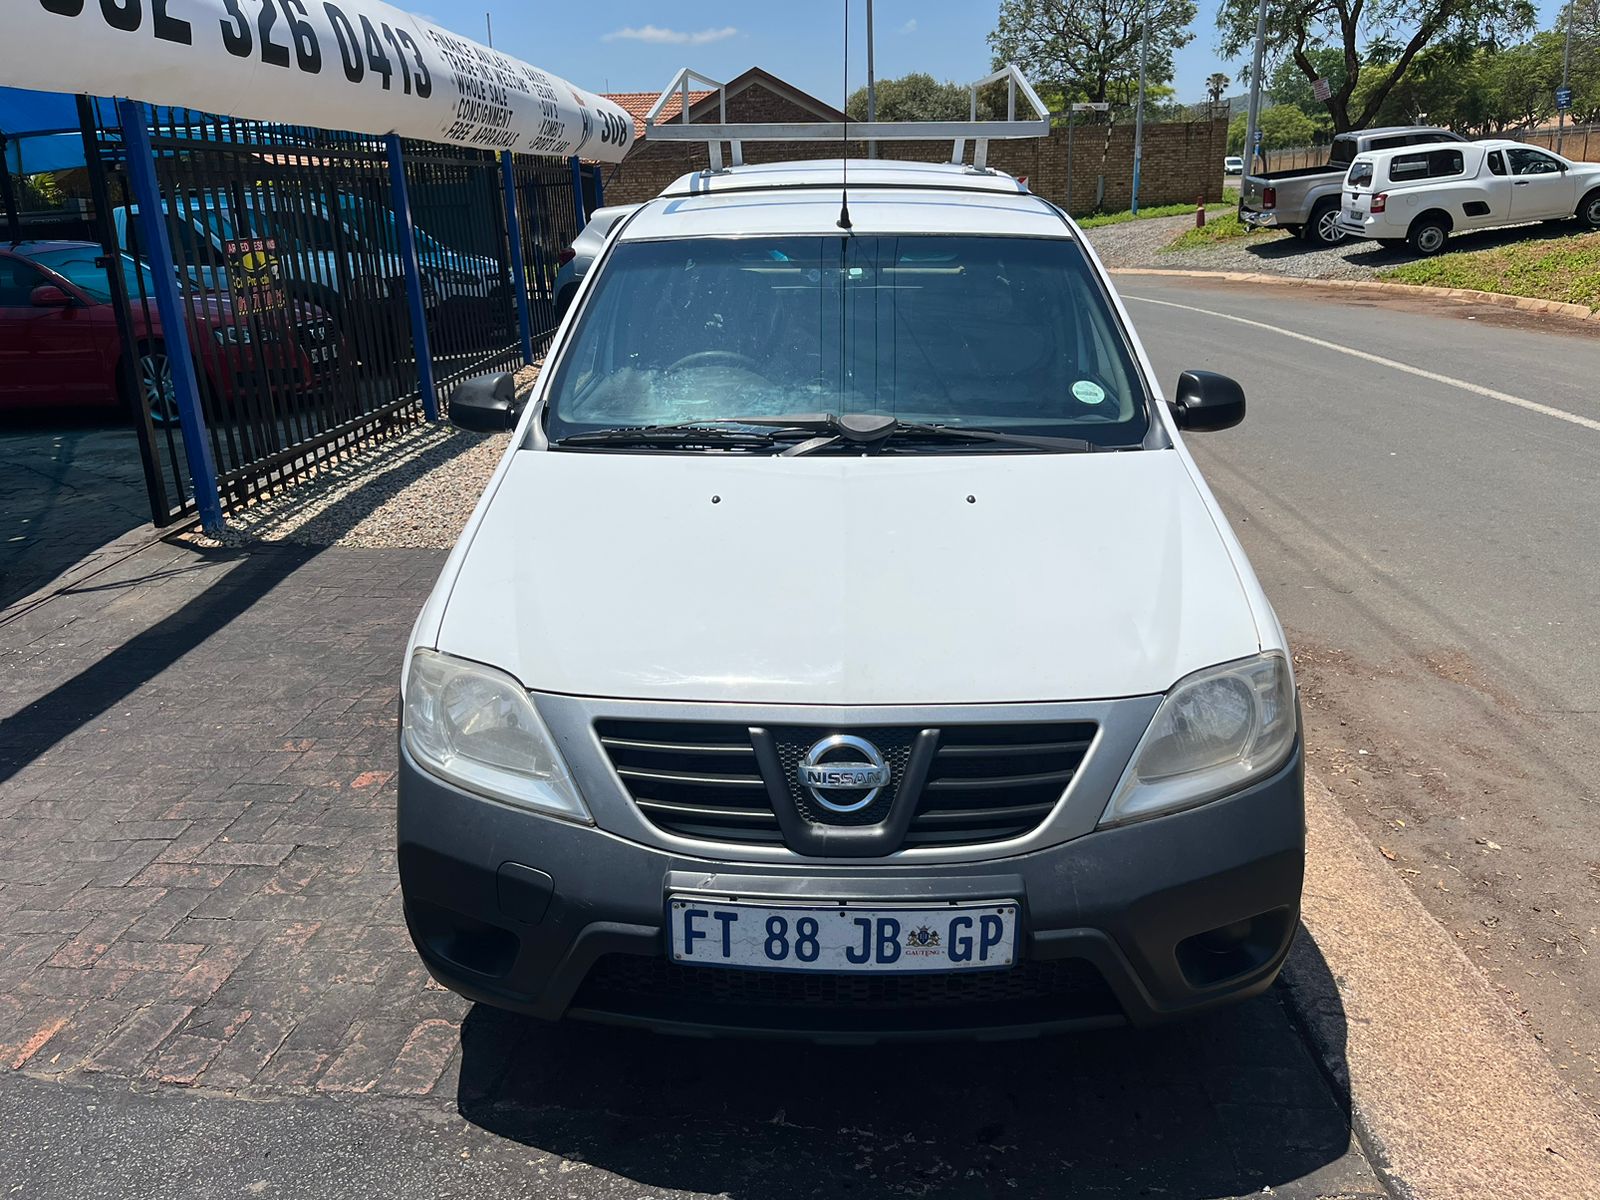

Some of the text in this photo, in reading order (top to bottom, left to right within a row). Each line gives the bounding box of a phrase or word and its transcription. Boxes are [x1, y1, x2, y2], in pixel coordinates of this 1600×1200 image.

[219, 0, 322, 74] 326
[323, 1, 432, 98] 0413
[428, 28, 475, 60] FINANCE
[454, 72, 508, 107] WHOLE SALE
[456, 97, 514, 129] CONSIGNMENT
[596, 108, 627, 148] 308
[443, 121, 521, 148] FREE APPRAISALS
[228, 240, 250, 254] ARED
[807, 771, 881, 784] NISSAN
[684, 909, 1004, 964] FT 88 JB GP
[905, 949, 940, 957] GAUTENG
